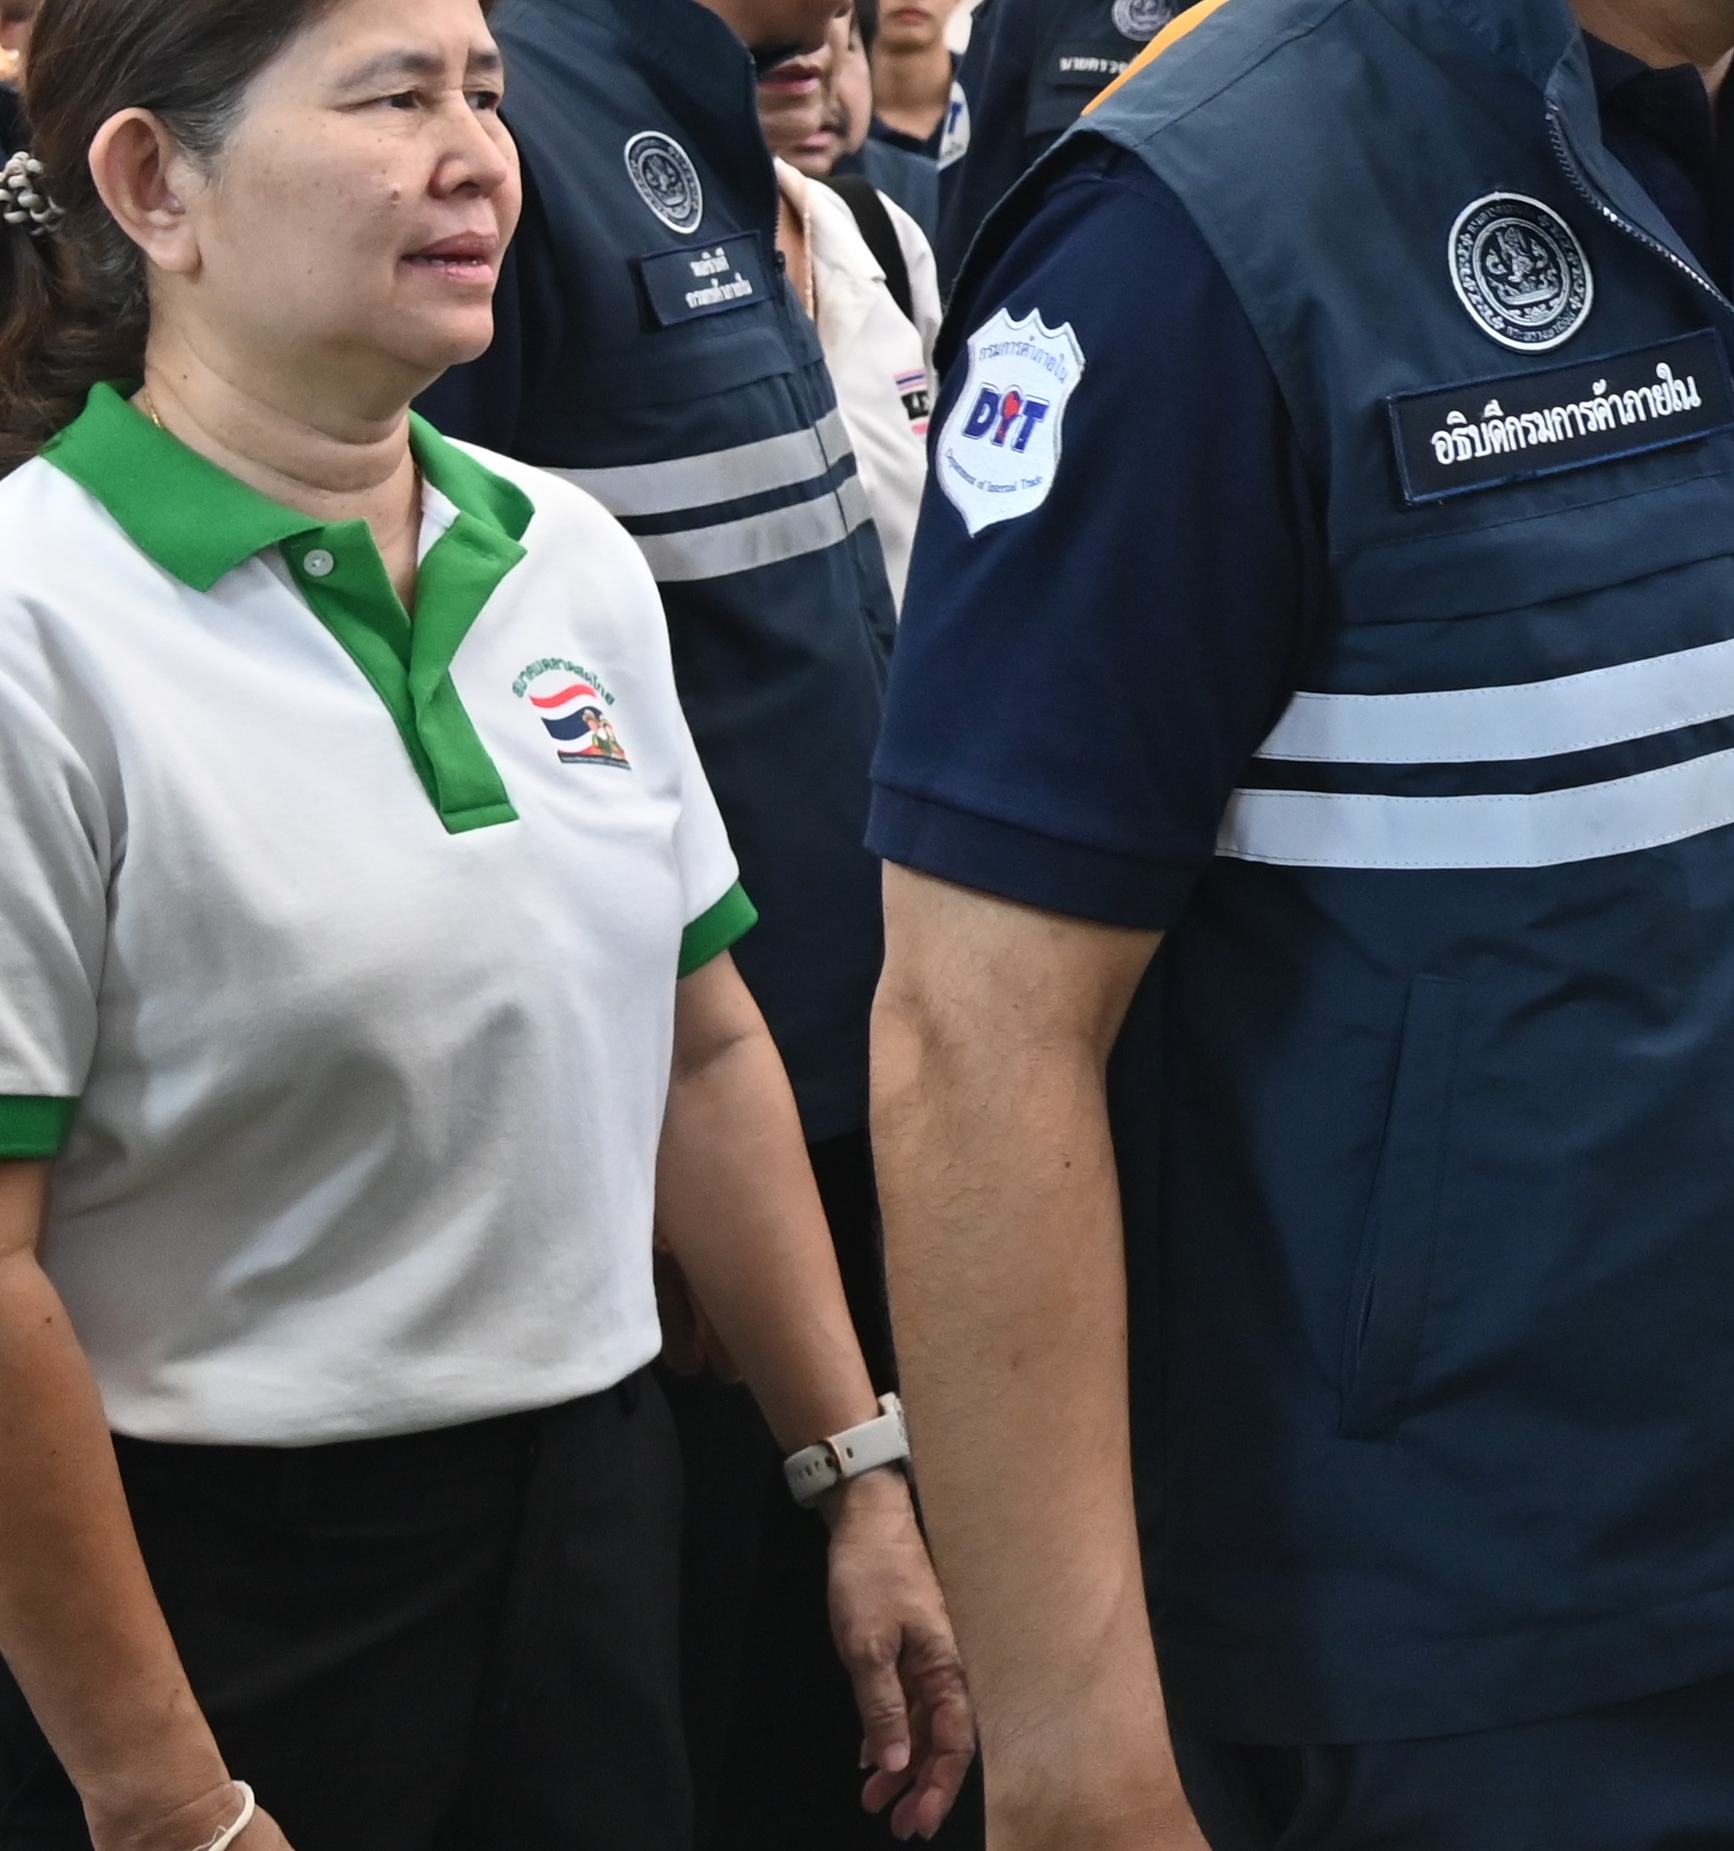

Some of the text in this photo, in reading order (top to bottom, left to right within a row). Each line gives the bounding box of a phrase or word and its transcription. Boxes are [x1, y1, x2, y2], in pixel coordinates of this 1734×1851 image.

[962, 382, 1050, 453] DIT
[1430, 361, 1701, 466] อธิบดีกรมการค้าภายใน
